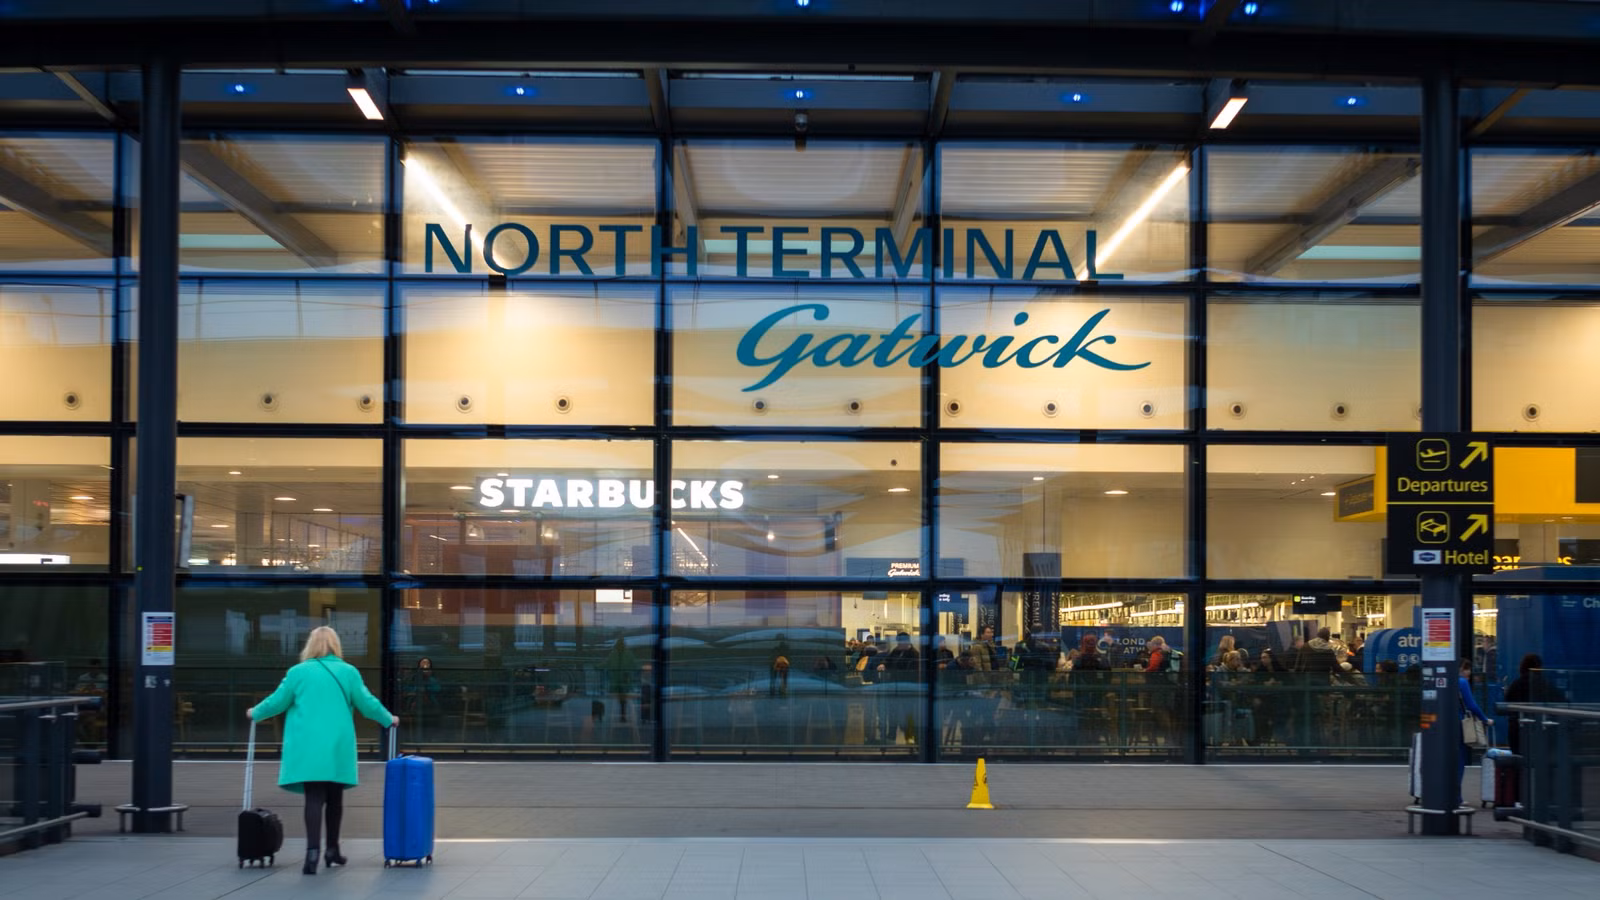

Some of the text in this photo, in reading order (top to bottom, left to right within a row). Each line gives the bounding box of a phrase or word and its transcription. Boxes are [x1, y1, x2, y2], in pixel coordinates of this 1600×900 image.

[424, 222, 1124, 282] NORTH TERMINAL
[736, 303, 1152, 392] Gatwick
[479, 478, 744, 509] STARBUCKS
[1397, 477, 1488, 495] Departures
[1444, 550, 1489, 565] Hotel
